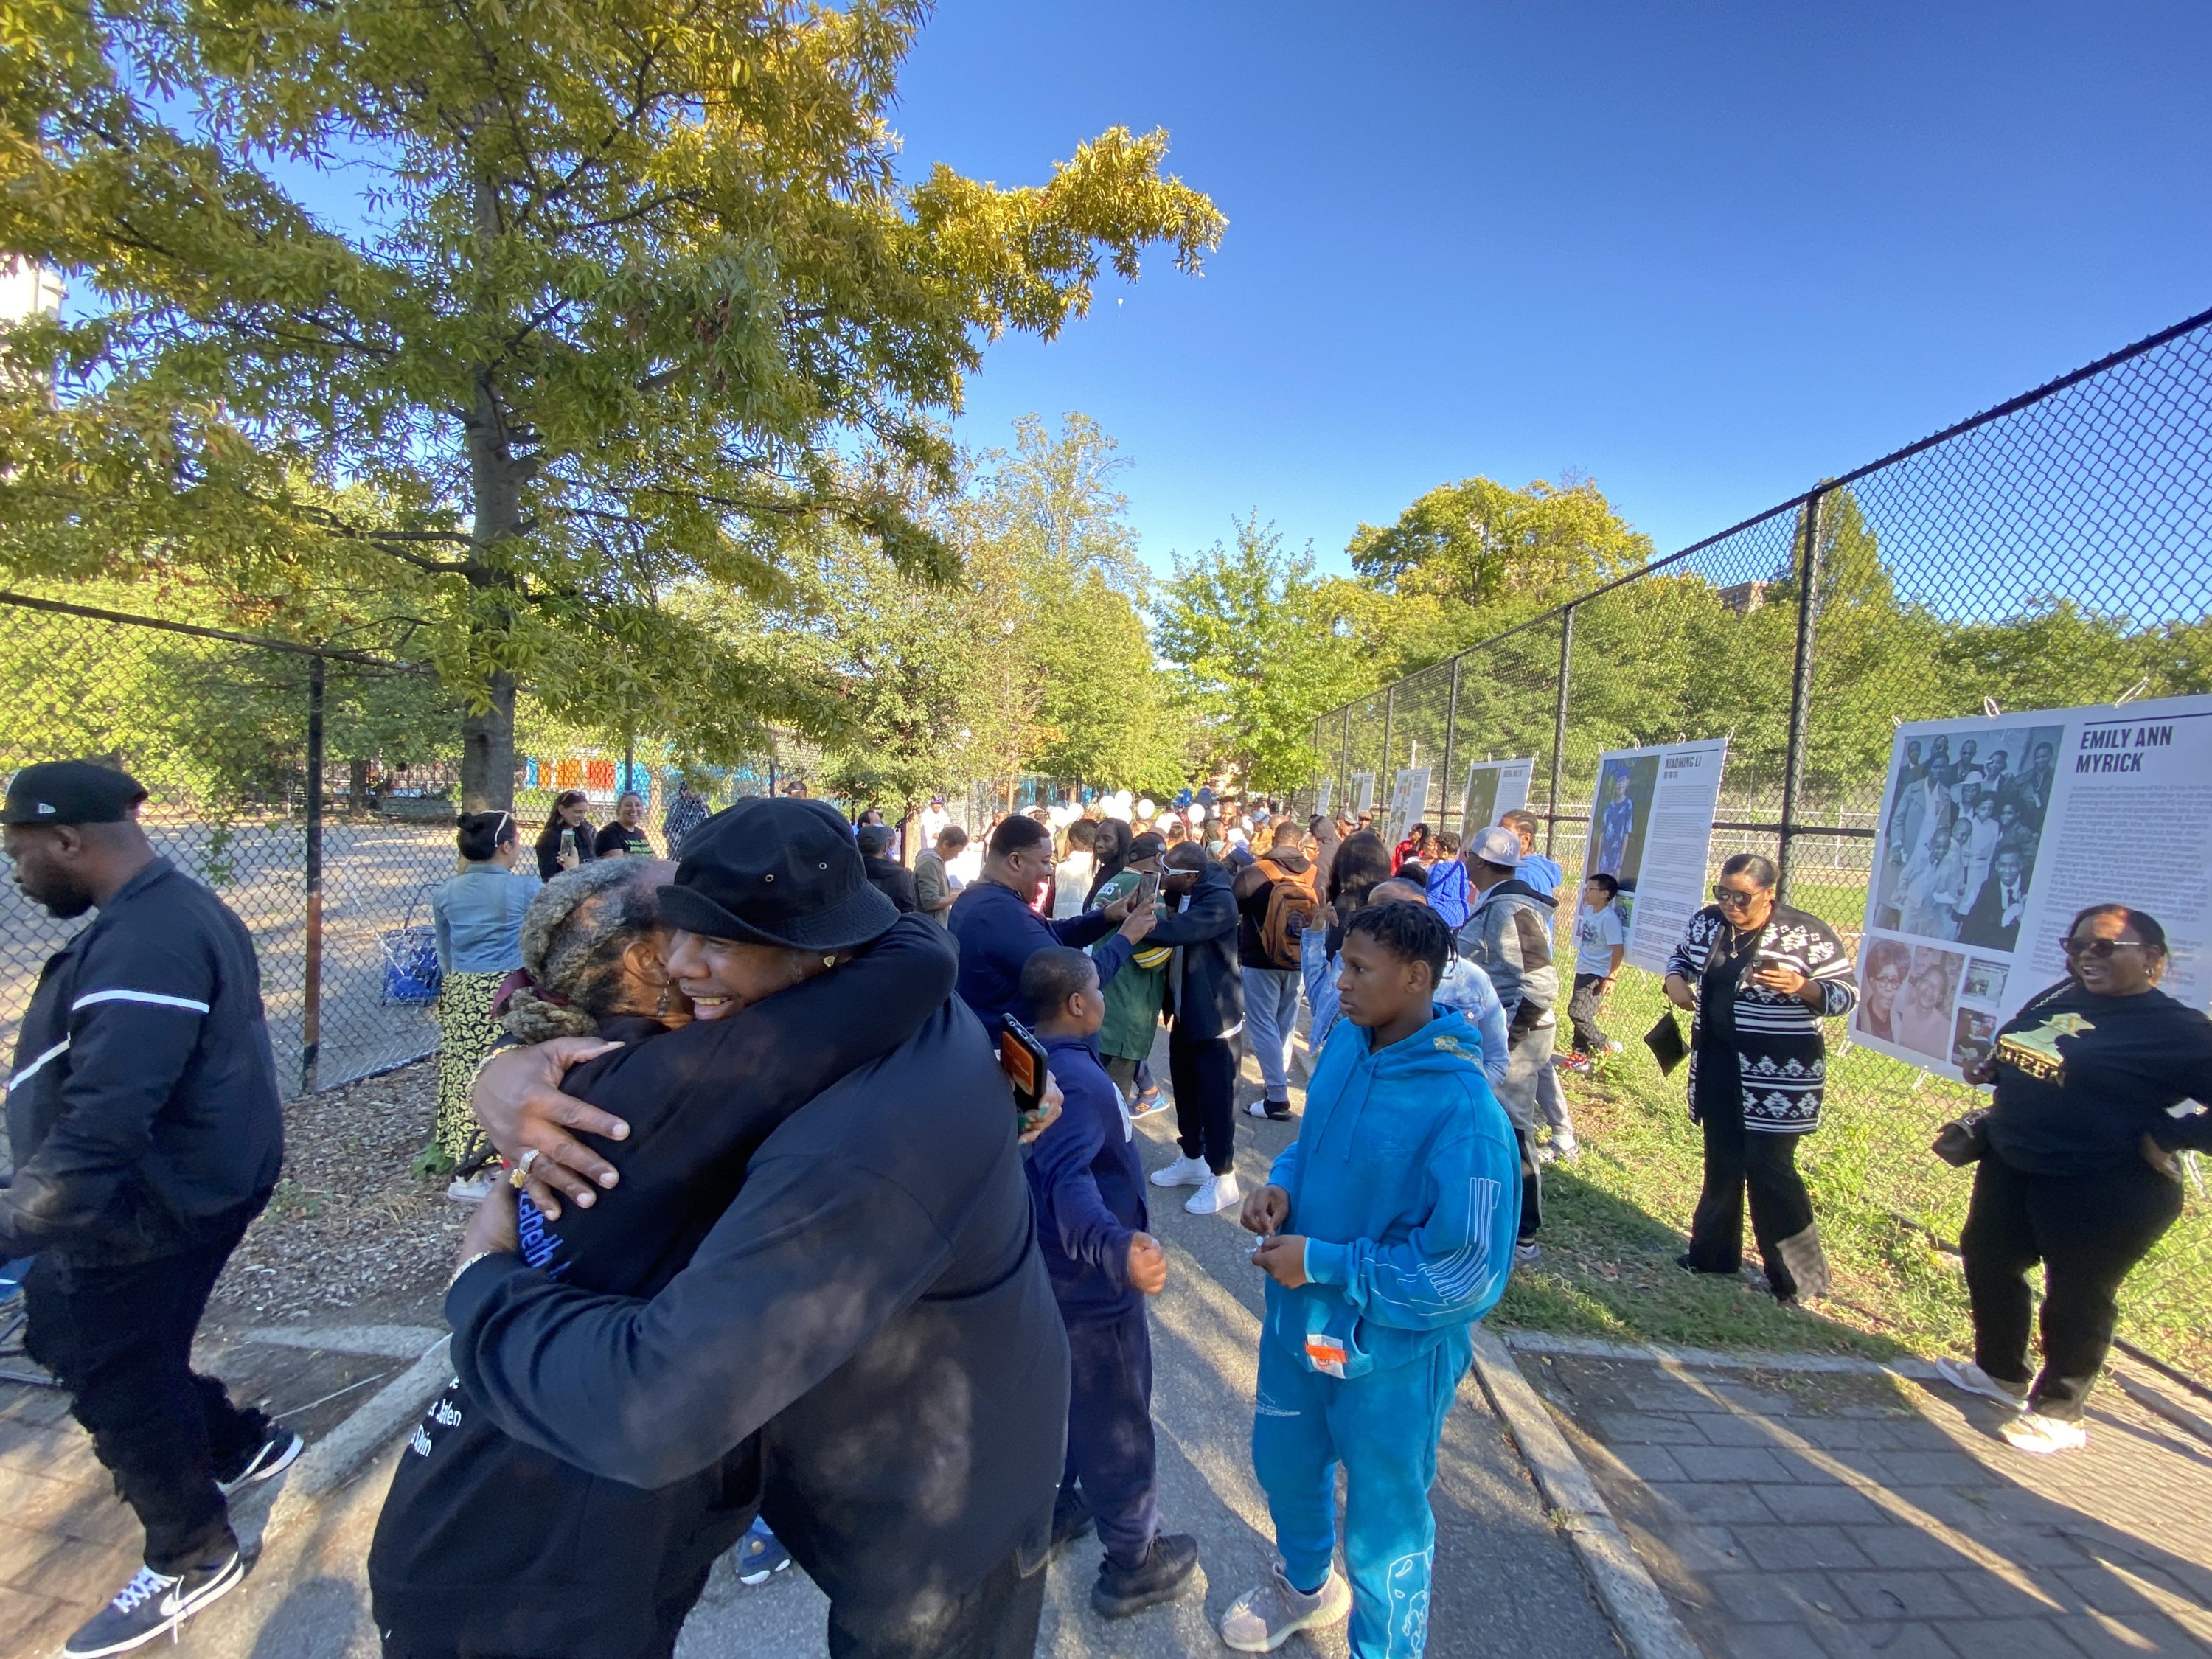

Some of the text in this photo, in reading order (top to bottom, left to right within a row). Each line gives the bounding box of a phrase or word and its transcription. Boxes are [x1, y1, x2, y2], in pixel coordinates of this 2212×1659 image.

[2080, 726, 2173, 749] EMILY ANN
[2076, 752, 2144, 773] MYRICK
